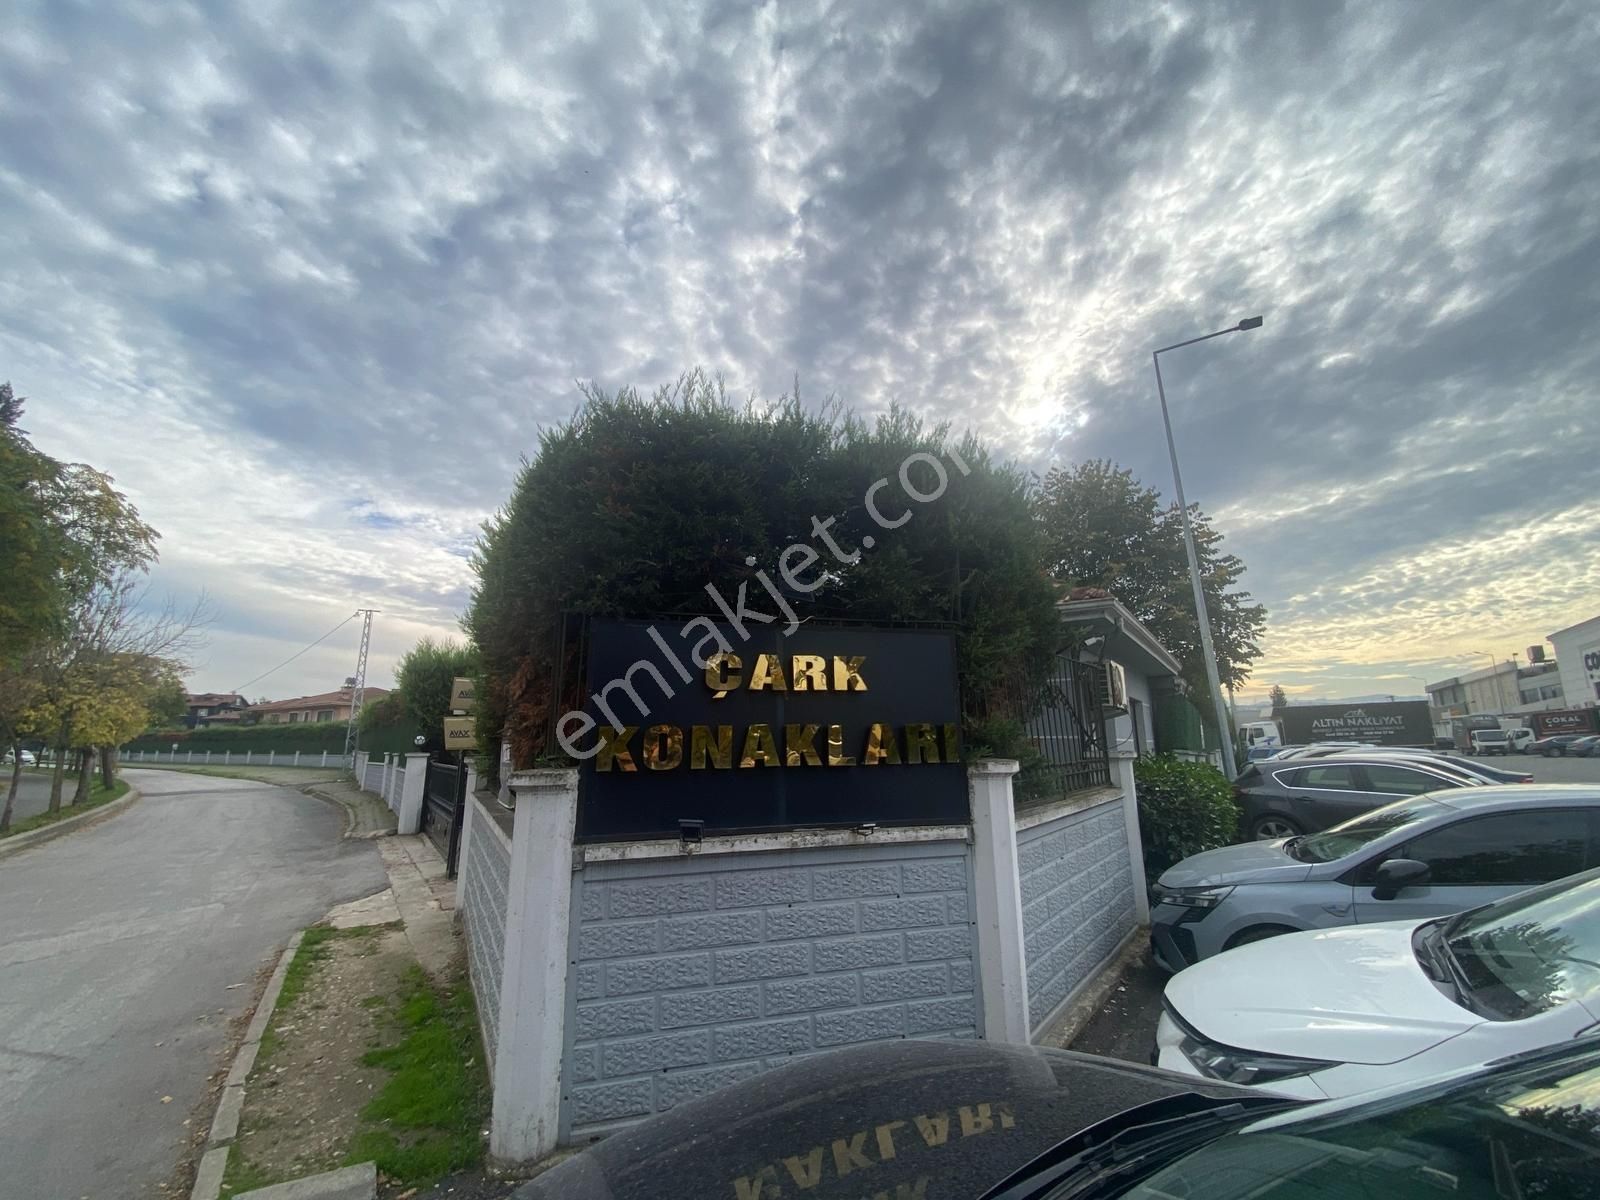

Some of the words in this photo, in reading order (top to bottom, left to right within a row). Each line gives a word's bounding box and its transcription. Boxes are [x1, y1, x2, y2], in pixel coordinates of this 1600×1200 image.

[705, 654, 868, 698] ÇARK
[1311, 717, 1344, 728] ALTIN
[594, 722, 960, 773] KONAKLARI
